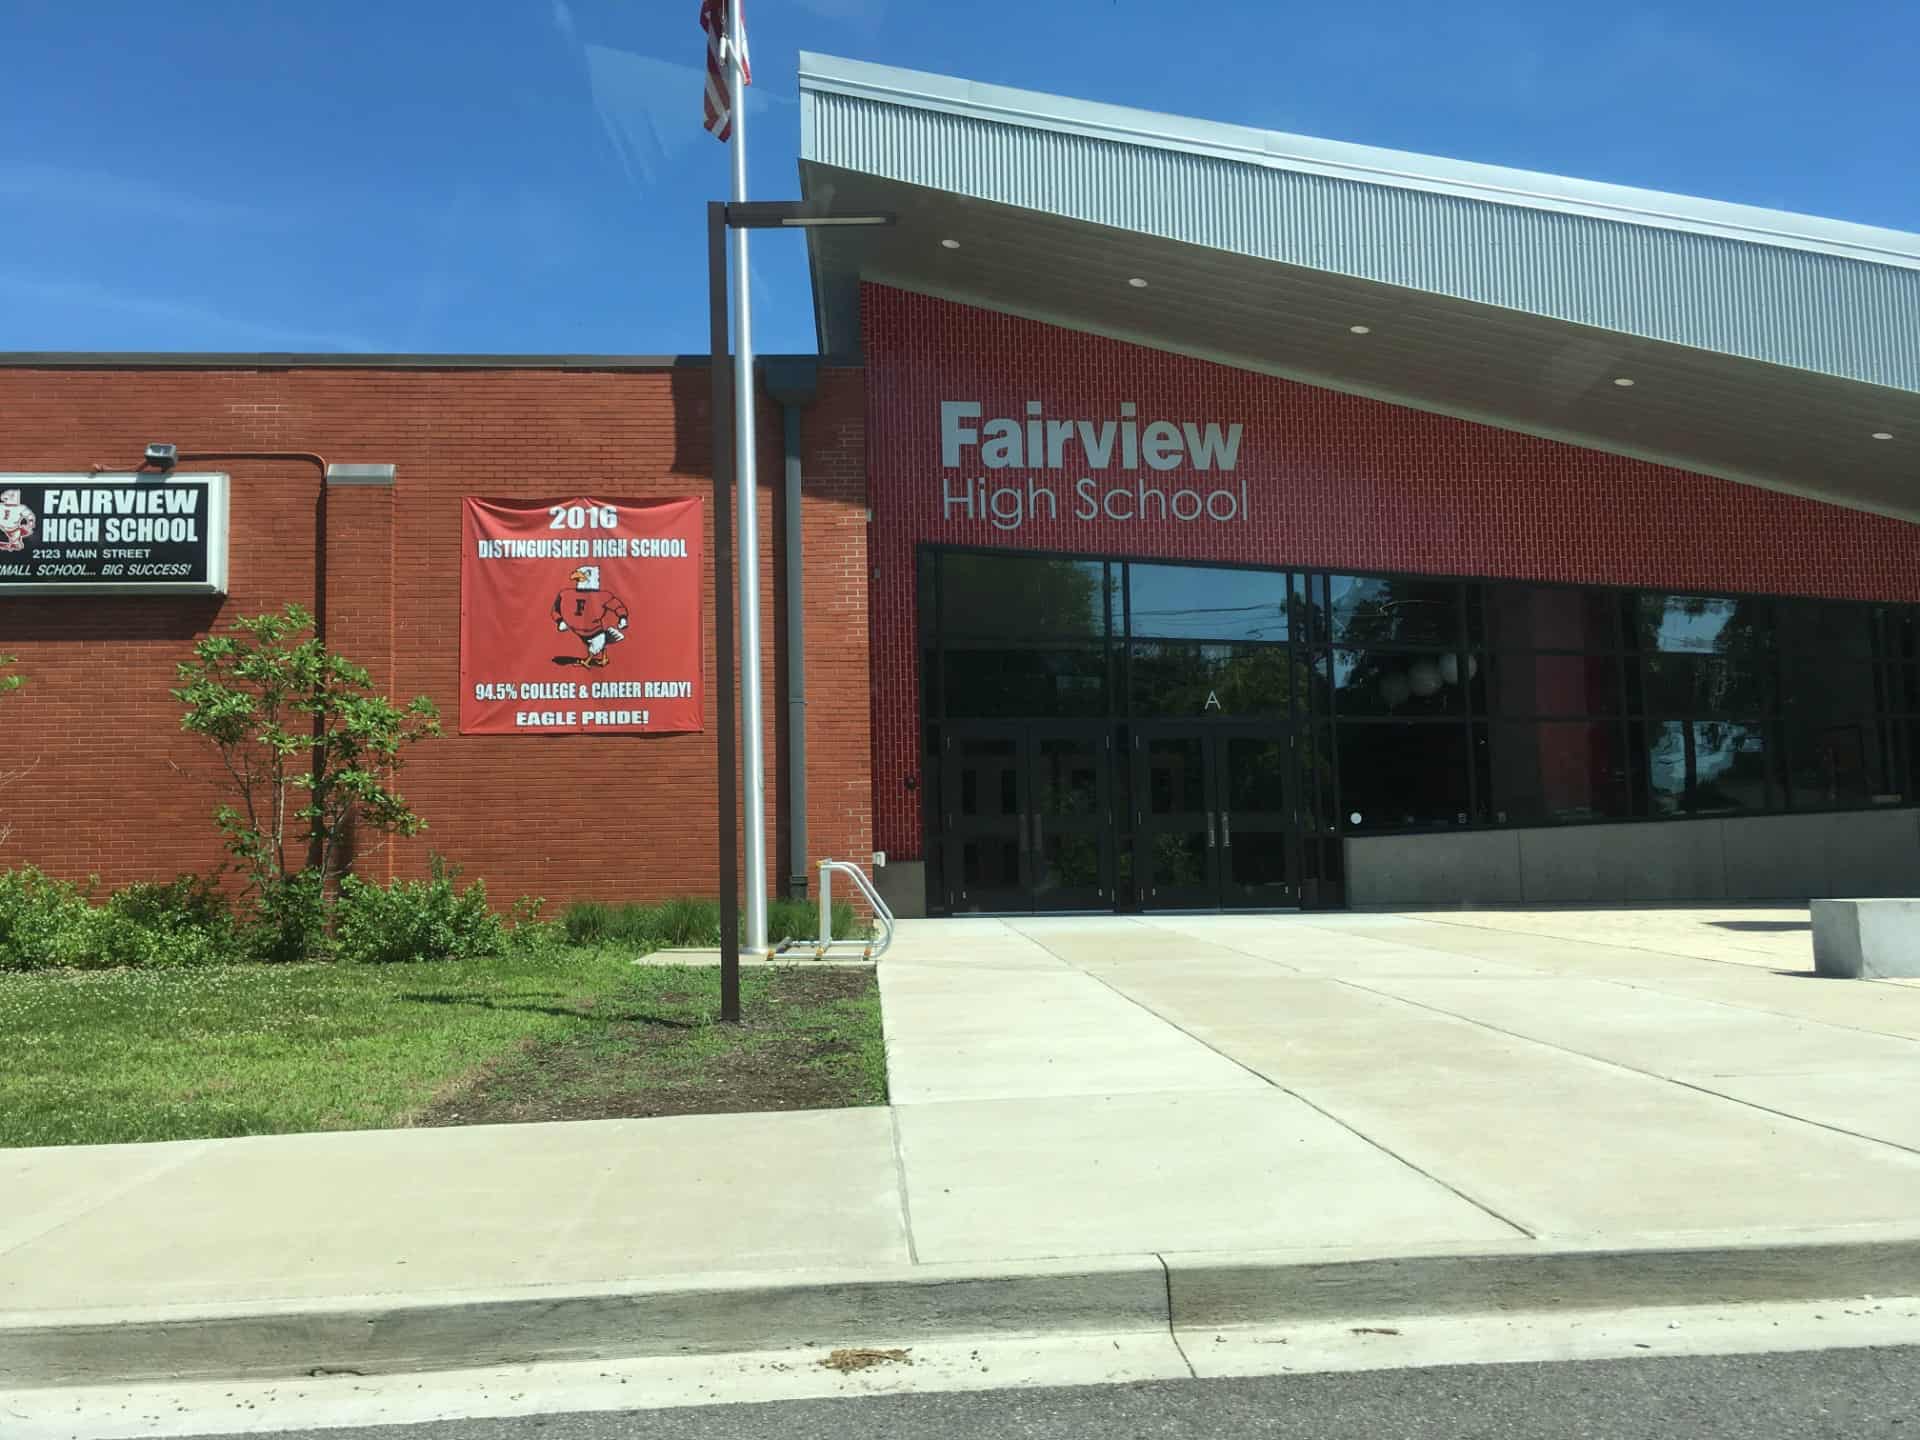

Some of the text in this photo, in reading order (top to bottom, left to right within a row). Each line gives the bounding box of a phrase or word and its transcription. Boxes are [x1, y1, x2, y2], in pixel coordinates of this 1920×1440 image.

[941, 400, 1243, 471] Fairview
[43, 489, 199, 514] FAIRVIEW
[943, 477, 1248, 530] High School
[549, 506, 618, 529] 2016
[42, 517, 199, 543] HIGH SCHOOL
[32, 548, 151, 559] 2123 MAIN STREET
[478, 538, 688, 559] DISTINGUISHED HIGH SCHOOL
[0, 564, 192, 577] MALL SCHOOL... BIG SUCCESS!
[574, 599, 586, 617] F
[475, 682, 692, 701] 94.5% COLLEGE & CAREER READY!
[1204, 690, 1221, 710] A
[516, 710, 650, 726] EAGLE PRIDE!
